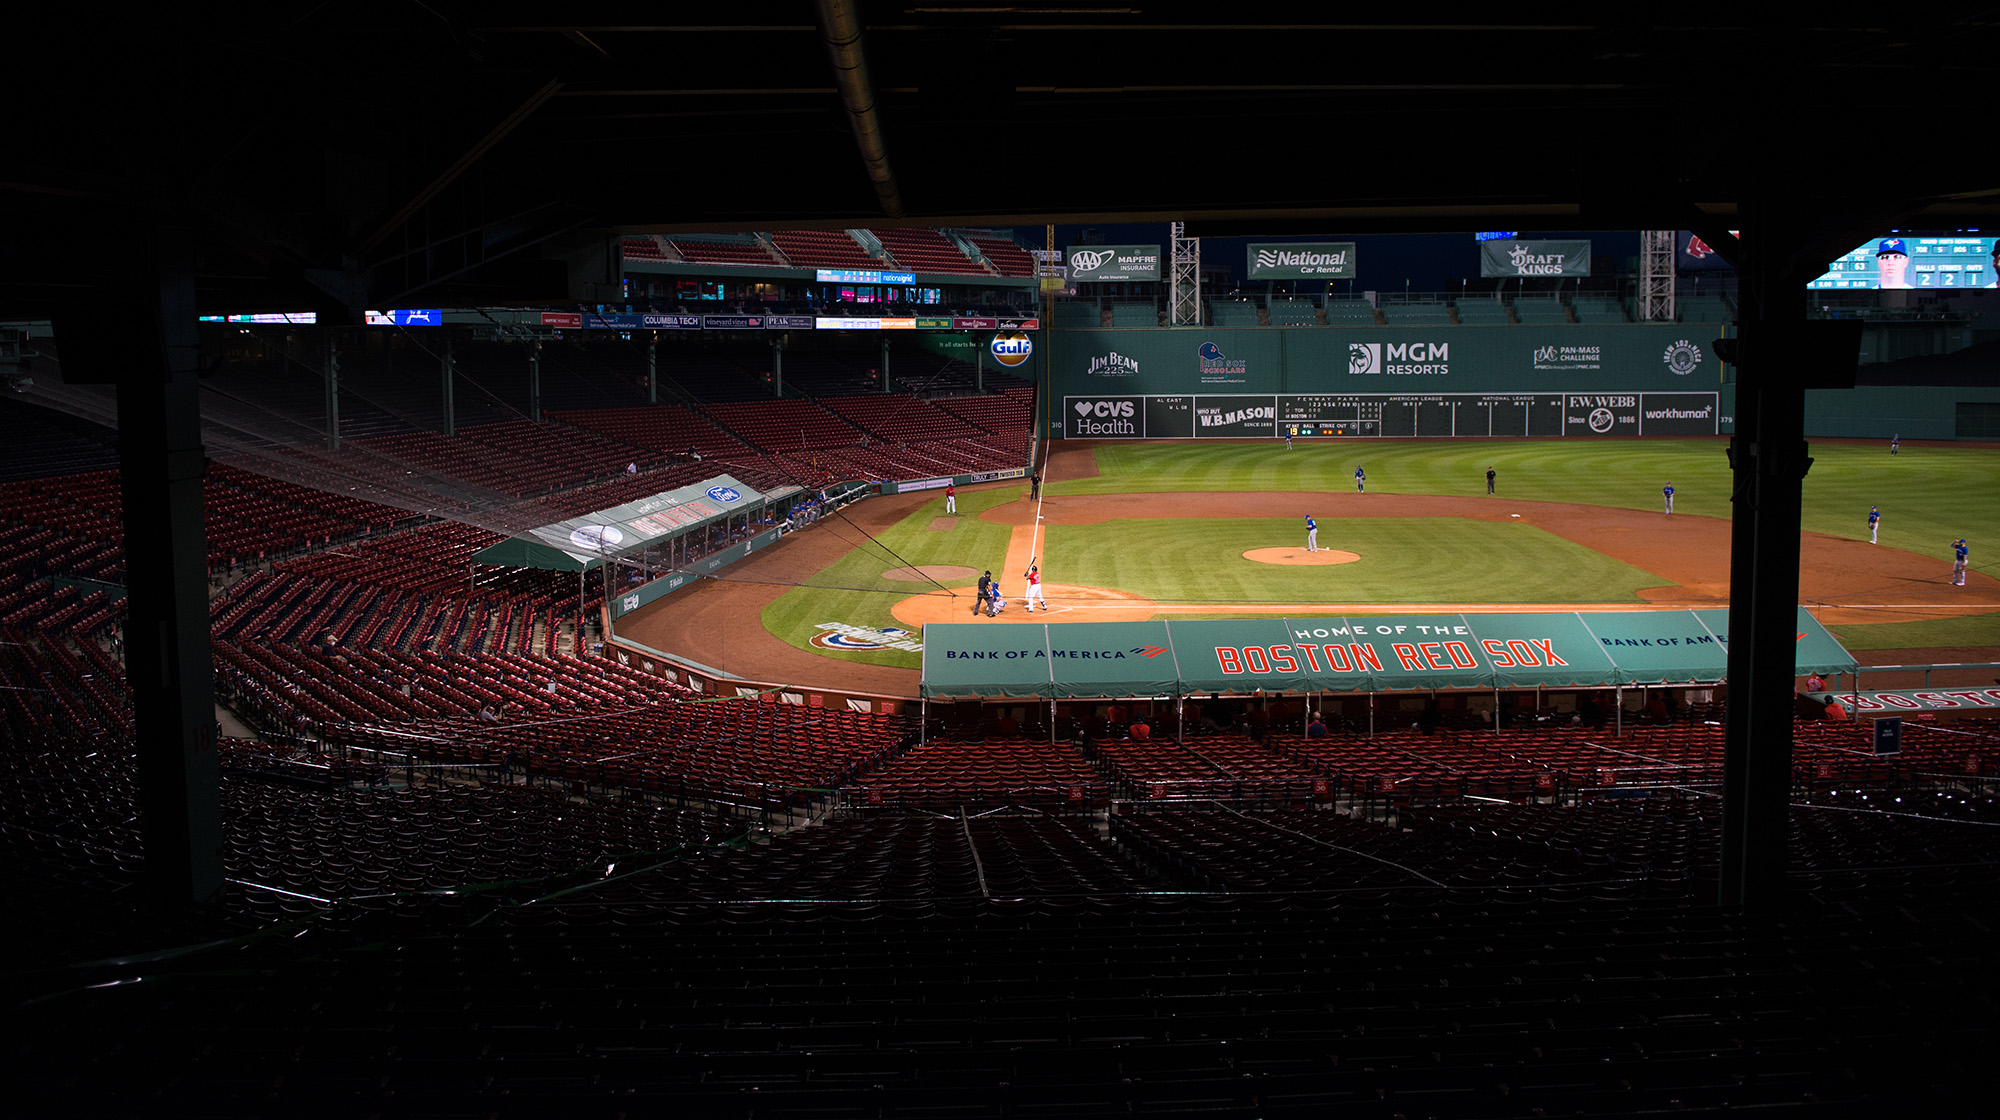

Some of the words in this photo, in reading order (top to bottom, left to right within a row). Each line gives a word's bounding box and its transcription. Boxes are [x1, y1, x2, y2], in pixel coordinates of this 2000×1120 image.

[1277, 251, 1347, 266] National
[1511, 253, 1565, 267] DRAFT
[1518, 264, 1563, 275] KINGS
[1832, 263, 1843, 271] 24
[1854, 262, 1866, 271] 63
[1921, 273, 1930, 286] 2
[1945, 273, 1954, 286] 2
[1971, 273, 1976, 286] 1
[645, 317, 679, 325] COLUMBIA
[679, 317, 699, 325] TECH
[706, 318, 732, 327] vineyard
[769, 317, 788, 325] PEAK
[993, 341, 1030, 354] Gulf
[1675, 339, 1689, 348] 103
[1387, 342, 1449, 362] MGM
[1560, 346, 1600, 354] PAN-MASS
[1088, 356, 1108, 374] JIM
[1110, 351, 1139, 374] BEAM
[1204, 360, 1224, 368] RED
[1226, 360, 1246, 368] SOX
[1104, 366, 1125, 374] 225
[1387, 364, 1449, 375] RESORTS
[1569, 396, 1595, 408] F.W.
[1596, 396, 1636, 408] WEBB
[1094, 401, 1135, 418] CVS
[1196, 408, 1210, 416] WHO
[1568, 416, 1585, 424] Since
[1619, 416, 1635, 424] 1866
[1077, 419, 1135, 435] Health
[1290, 428, 1298, 436] 19
[1295, 626, 1369, 639] HOME
[1375, 625, 1407, 635] OF
[1416, 625, 1469, 635] THE
[1600, 637, 1653, 647] BANK
[1656, 637, 1680, 647] OF
[947, 650, 999, 660] BANK
[1005, 650, 1029, 660] OF
[1035, 650, 1126, 660] AMERICA
[1215, 643, 1385, 674] BOSTON
[1390, 640, 1479, 671] RED
[1481, 638, 1570, 667] SOX
[192, 723, 211, 754] 18
